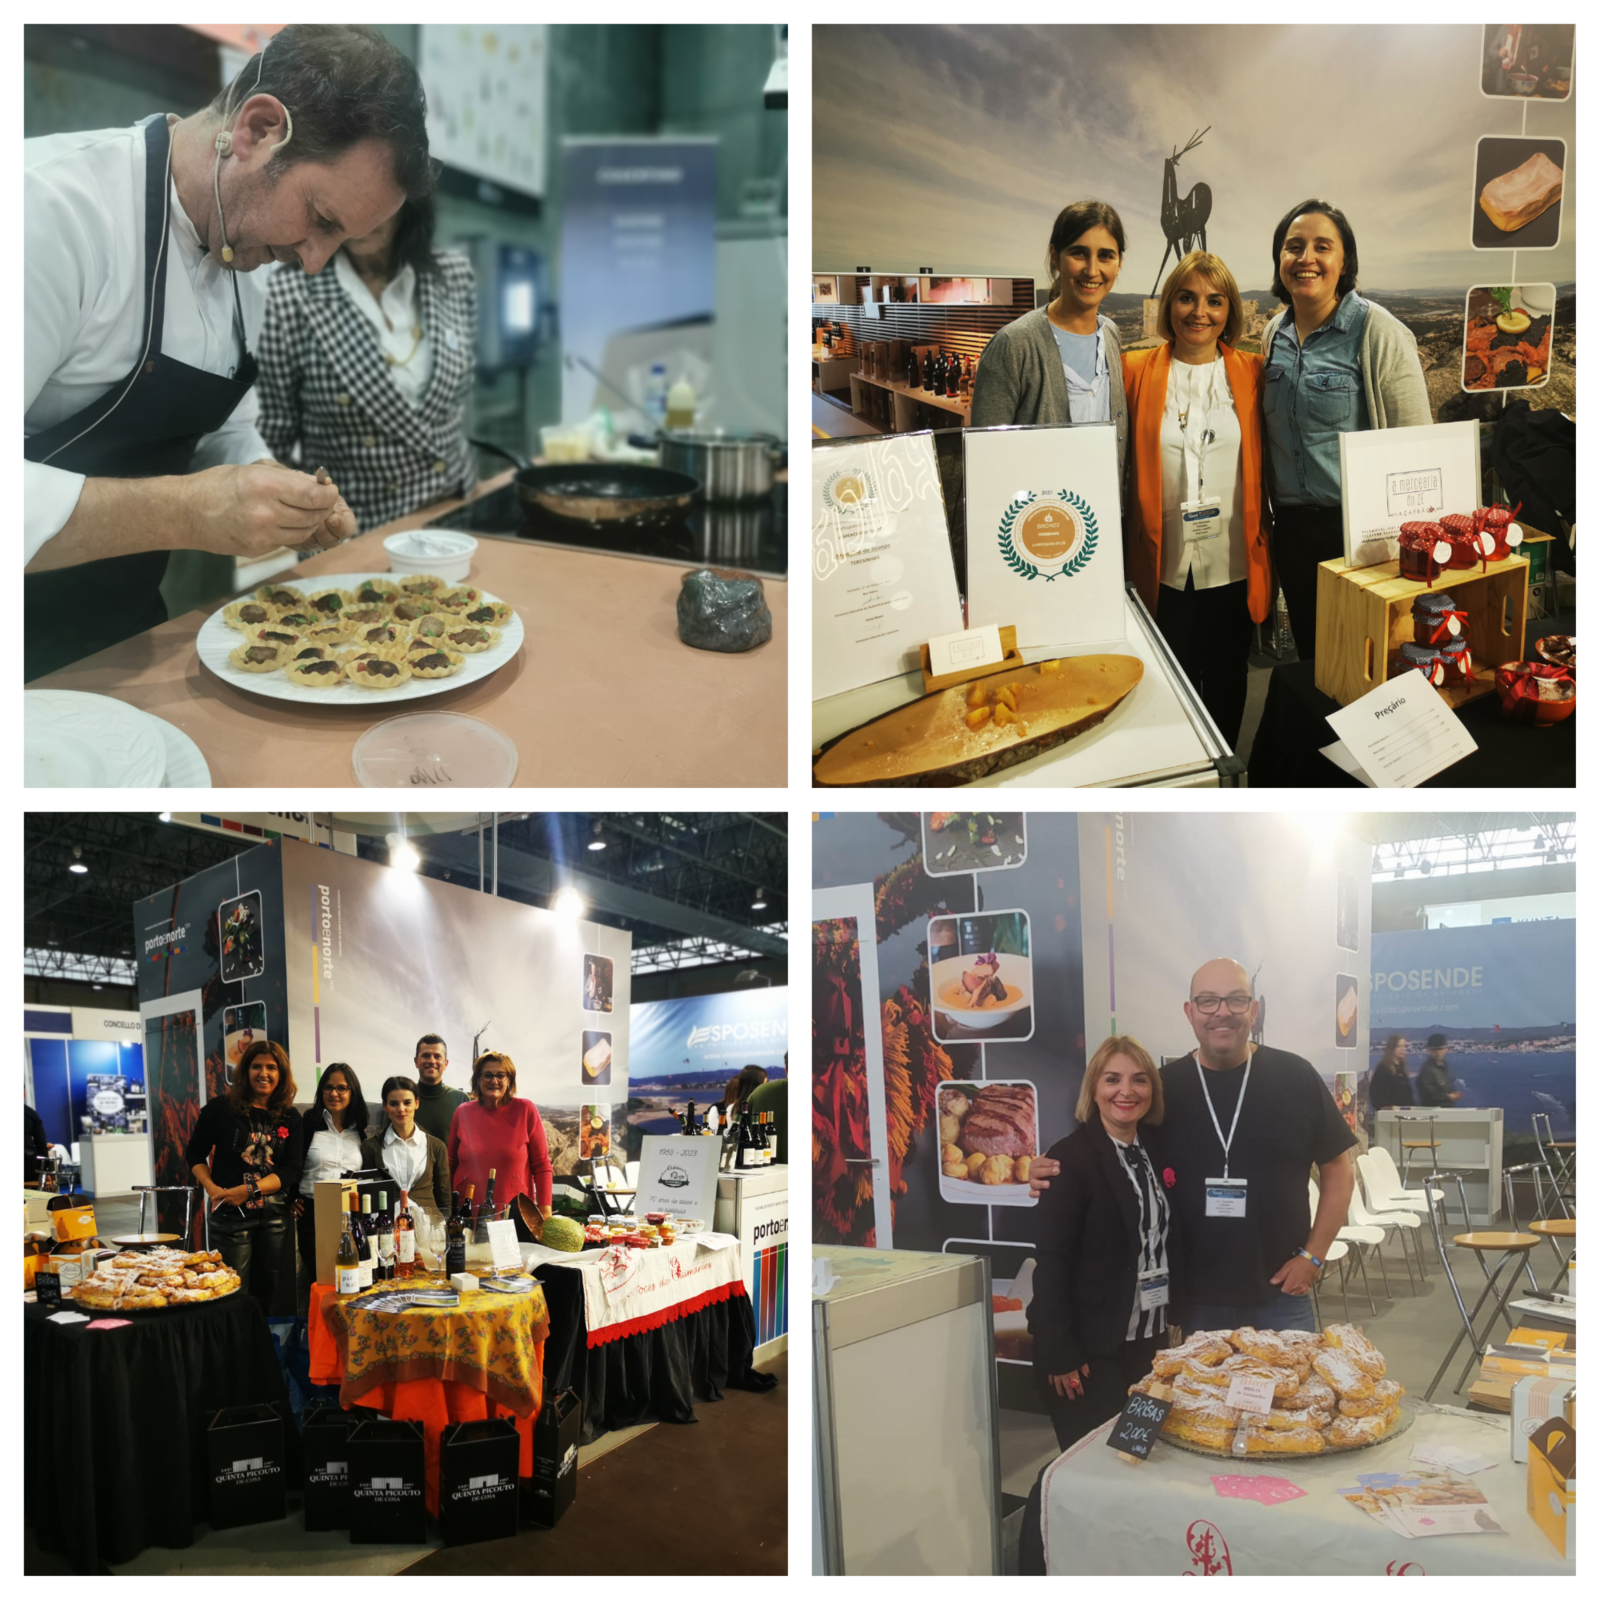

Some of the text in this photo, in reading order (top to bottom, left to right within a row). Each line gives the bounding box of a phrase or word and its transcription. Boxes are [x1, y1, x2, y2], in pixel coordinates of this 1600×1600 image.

[1400, 474, 1438, 491] mercearia
[1374, 697, 1406, 720] Preçário
[1115, 812, 1126, 880] norte
[145, 926, 186, 954] portoenorte
[318, 884, 334, 979] portoenorte
[104, 1020, 136, 1029] CONCELLO
[1127, 1396, 1165, 1422] BRISAS
[215, 1466, 280, 1484] QUINTA PICOUTO
[309, 1474, 339, 1483] QUINTA
[452, 1483, 515, 1500] QUINTA PICOUTO
